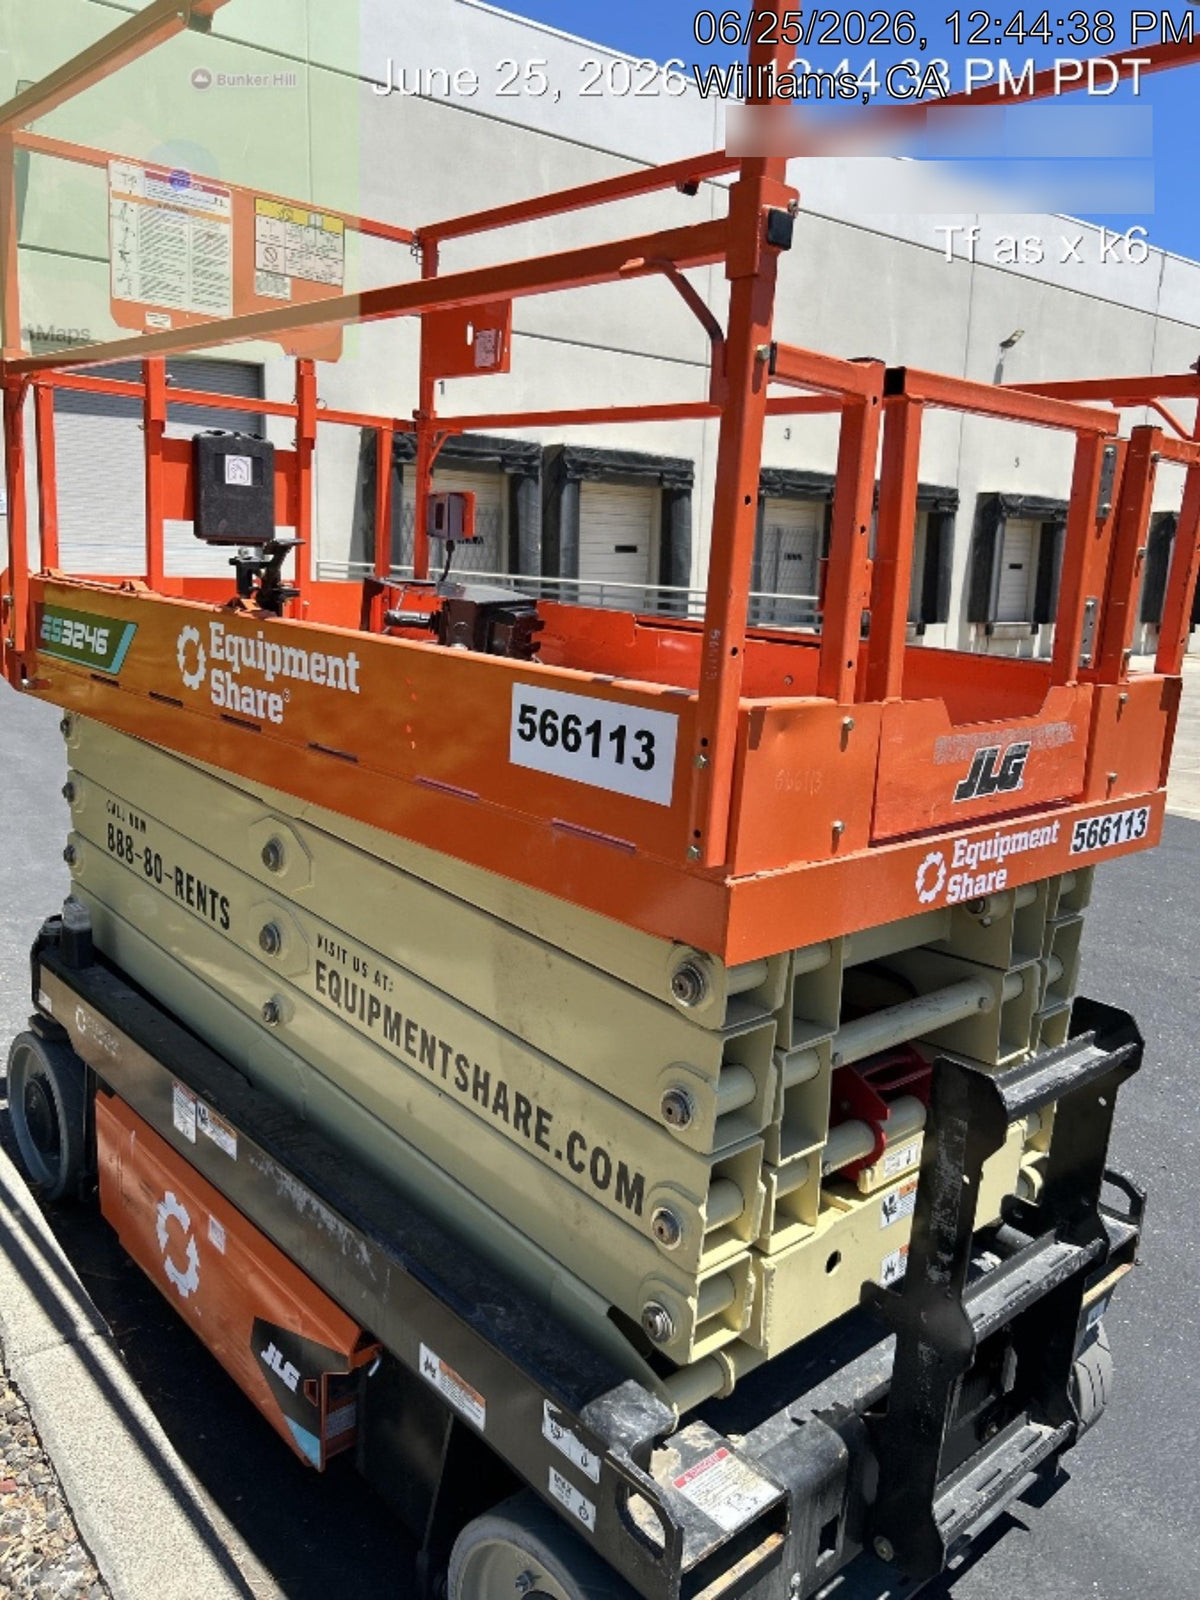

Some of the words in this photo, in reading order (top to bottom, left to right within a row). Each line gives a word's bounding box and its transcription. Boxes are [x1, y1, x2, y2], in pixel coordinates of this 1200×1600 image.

[209, 621, 360, 694] Equipment
[211, 668, 284, 724] Share
[517, 703, 656, 771] 566113
[953, 740, 1031, 802] JLG
[951, 820, 1061, 872] Equipment
[1072, 809, 1147, 852] 566113
[107, 822, 230, 931] 888-80-RENTS
[946, 868, 1008, 905] Share
[317, 933, 347, 965] VISIT
[353, 956, 368, 978] US
[372, 969, 394, 992] AT:
[315, 959, 646, 1217] EQUIPMENTSHARE.COM
[260, 1342, 301, 1393] JLG
